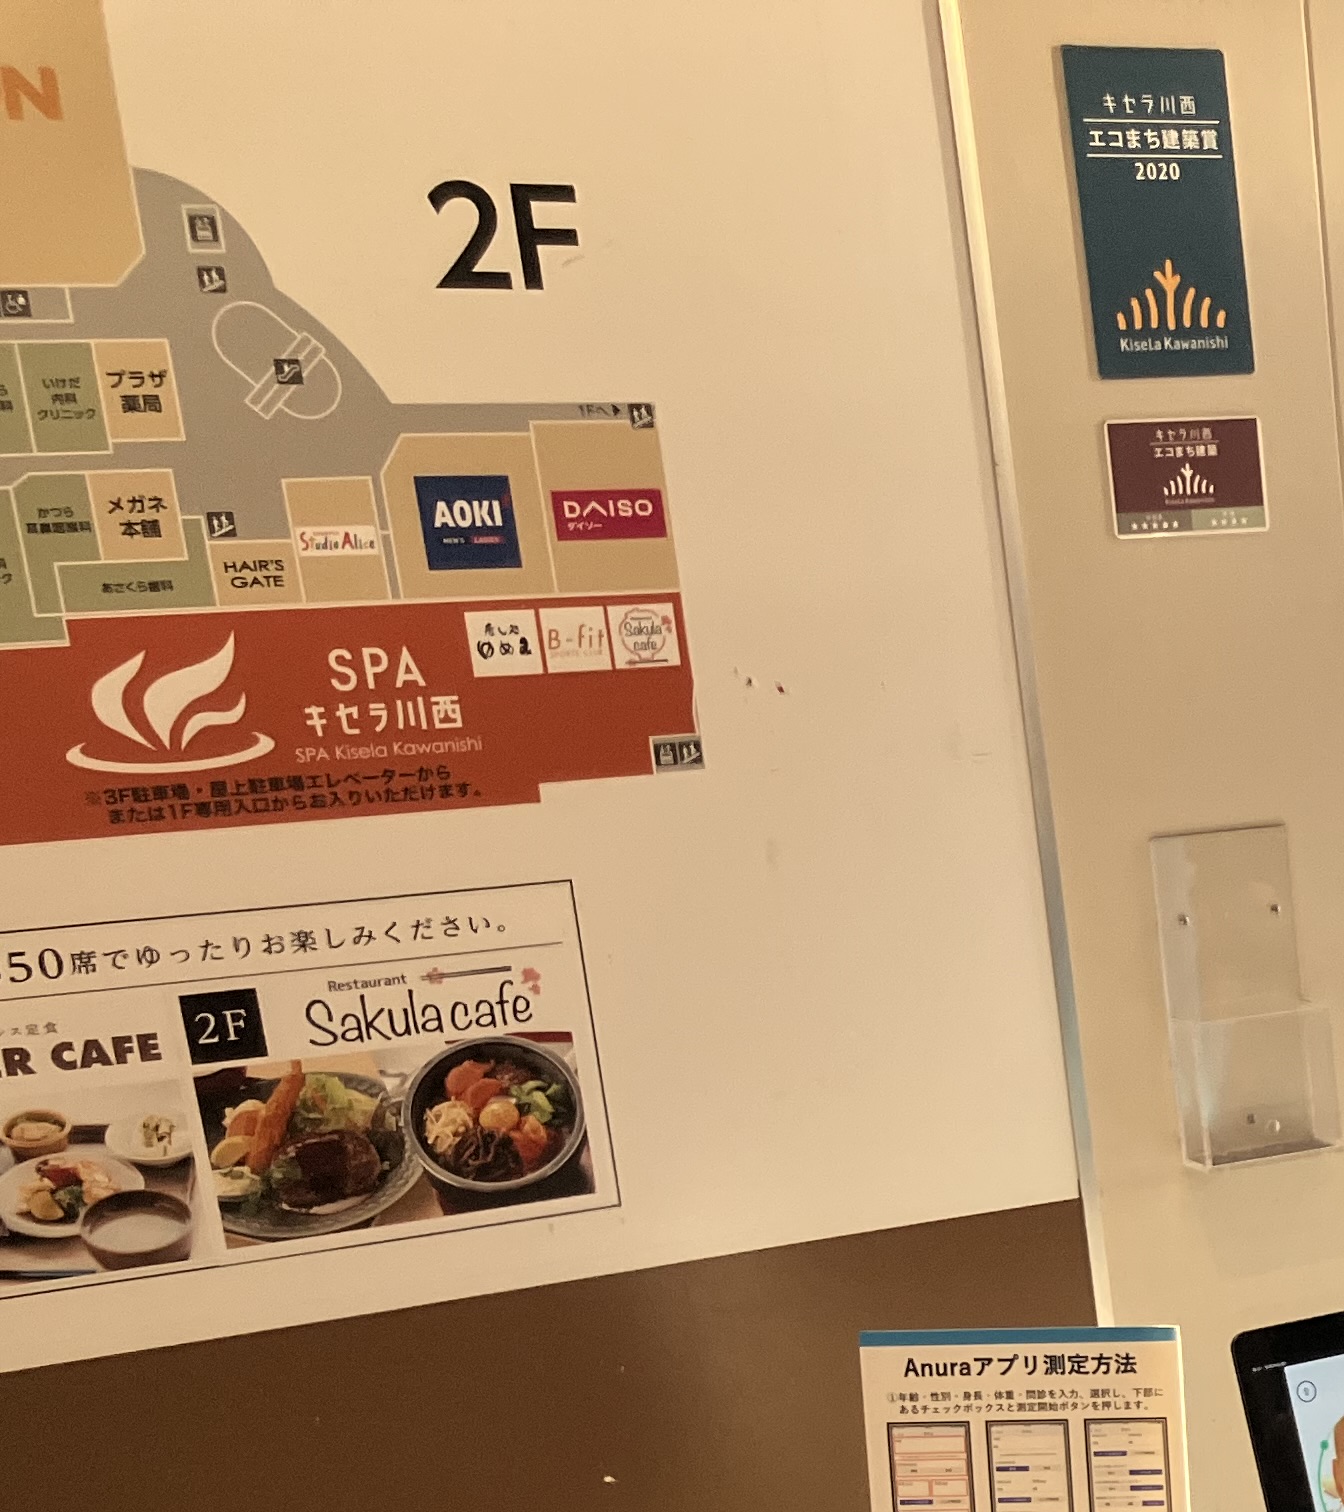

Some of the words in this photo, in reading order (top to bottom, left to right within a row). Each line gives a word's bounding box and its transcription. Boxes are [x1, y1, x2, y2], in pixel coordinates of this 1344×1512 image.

[1102, 92, 1197, 116] キセラ川西
[1088, 128, 1219, 151] エコまち建築賞
[1134, 161, 1181, 181] 2020
[428, 180, 579, 292] 2F
[1164, 333, 1230, 352] Kawanishi
[105, 370, 169, 389] プラザ
[119, 394, 163, 414] 薬局
[107, 495, 168, 515] メガネ
[433, 500, 504, 529] AOKI
[562, 498, 655, 519] DAISO
[223, 559, 286, 574] HAIR'S
[230, 575, 286, 589] GATE
[327, 645, 428, 692] SPA
[303, 695, 464, 738] キセラ川西
[295, 747, 331, 764] SPA
[334, 743, 389, 762] Kisela
[392, 734, 483, 757] Kawanishi
[0, 915, 507, 983] 50席でゆったりお楽しみください。
[326, 973, 408, 993] Restaurant
[304, 988, 445, 1047] Sakula
[450, 979, 533, 1032] cafe
[193, 1008, 248, 1045] 2F
[50, 1032, 163, 1071] CAFE
[903, 1352, 1138, 1378] Anuraアプリ測定方法
